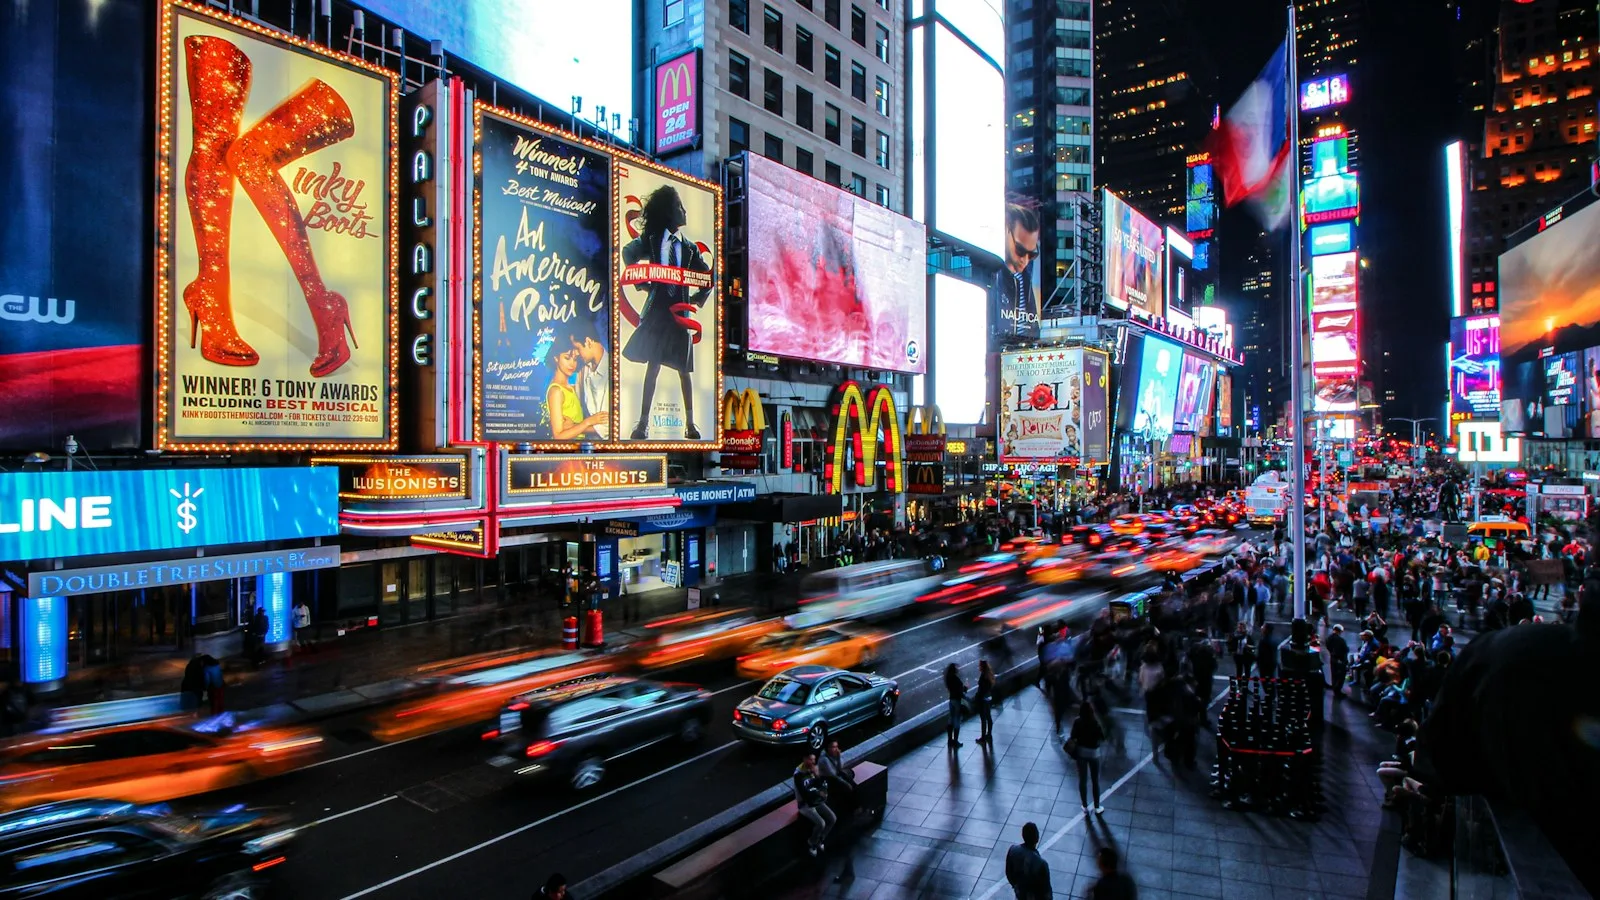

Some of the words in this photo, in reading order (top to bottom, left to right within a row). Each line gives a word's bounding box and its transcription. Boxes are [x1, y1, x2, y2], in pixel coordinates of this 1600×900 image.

[662, 101, 690, 119] OPEN
[665, 113, 687, 135] 24
[658, 129, 693, 148] HOURS
[512, 134, 585, 175] Winner!
[515, 160, 529, 175] 4
[530, 165, 549, 180] TONY
[550, 171, 579, 189] AWARDS
[501, 179, 541, 201] Best
[541, 189, 597, 215] Musical!
[303, 201, 379, 239] Boots
[1305, 206, 1357, 222] TOSHIBA
[412, 104, 435, 367] PALACE
[514, 205, 546, 252] An
[490, 234, 603, 312] American
[625, 266, 647, 281] FINAL
[649, 266, 681, 282] MONTHS
[0, 294, 75, 324] CW
[8, 304, 24, 312] THE
[510, 287, 577, 331] Paris
[1000, 309, 1039, 323] NAUTICA
[486, 361, 499, 373] Set
[497, 360, 516, 376] your
[516, 357, 540, 368] heart
[501, 369, 533, 383] racing
[182, 374, 256, 396] WINNER!
[262, 378, 271, 397] 6
[276, 380, 316, 399] TONY
[320, 382, 378, 401] AWARDS
[183, 396, 261, 408] INCLUDING
[266, 399, 307, 410] BEST
[312, 401, 378, 413] MUSICAL
[182, 410, 283, 420] KINKYBOOTSTHEMUSICAL.COM
[302, 413, 326, 421] TICKETS
[328, 414, 341, 422] CALL
[1088, 410, 1102, 431] CATS
[388, 468, 411, 477] THE
[585, 461, 604, 470] THE
[982, 463, 1009, 471] GIFS
[353, 477, 459, 490] ILLUSIONISTS
[530, 471, 648, 488] ILLUSIONISTS
[675, 490, 699, 501] ANGE
[701, 489, 733, 500] MONEY
[737, 488, 755, 498] ATM
[605, 527, 638, 537] EXCHANGE
[289, 551, 306, 560] BY
